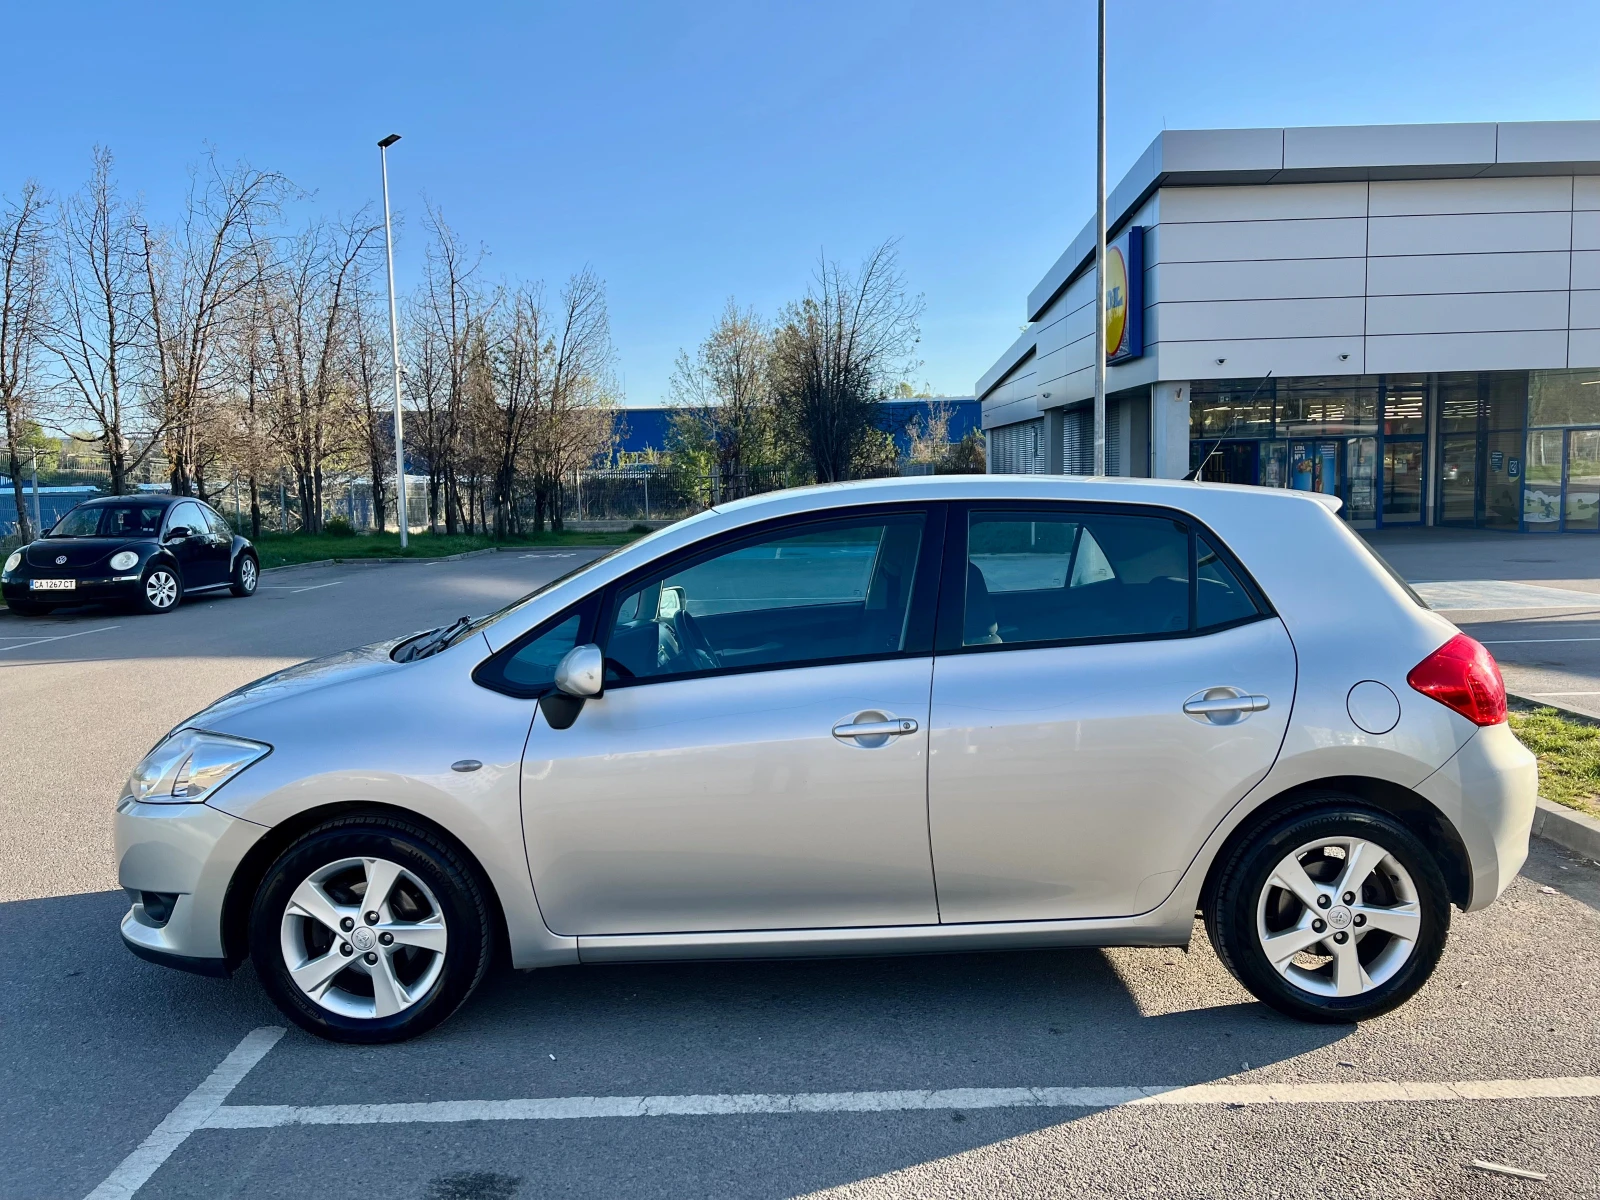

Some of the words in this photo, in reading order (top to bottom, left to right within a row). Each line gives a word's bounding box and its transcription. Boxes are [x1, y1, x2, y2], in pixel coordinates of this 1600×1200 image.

[34, 580, 44, 588] CA
[45, 580, 62, 588] 1267
[63, 580, 74, 588] CT
